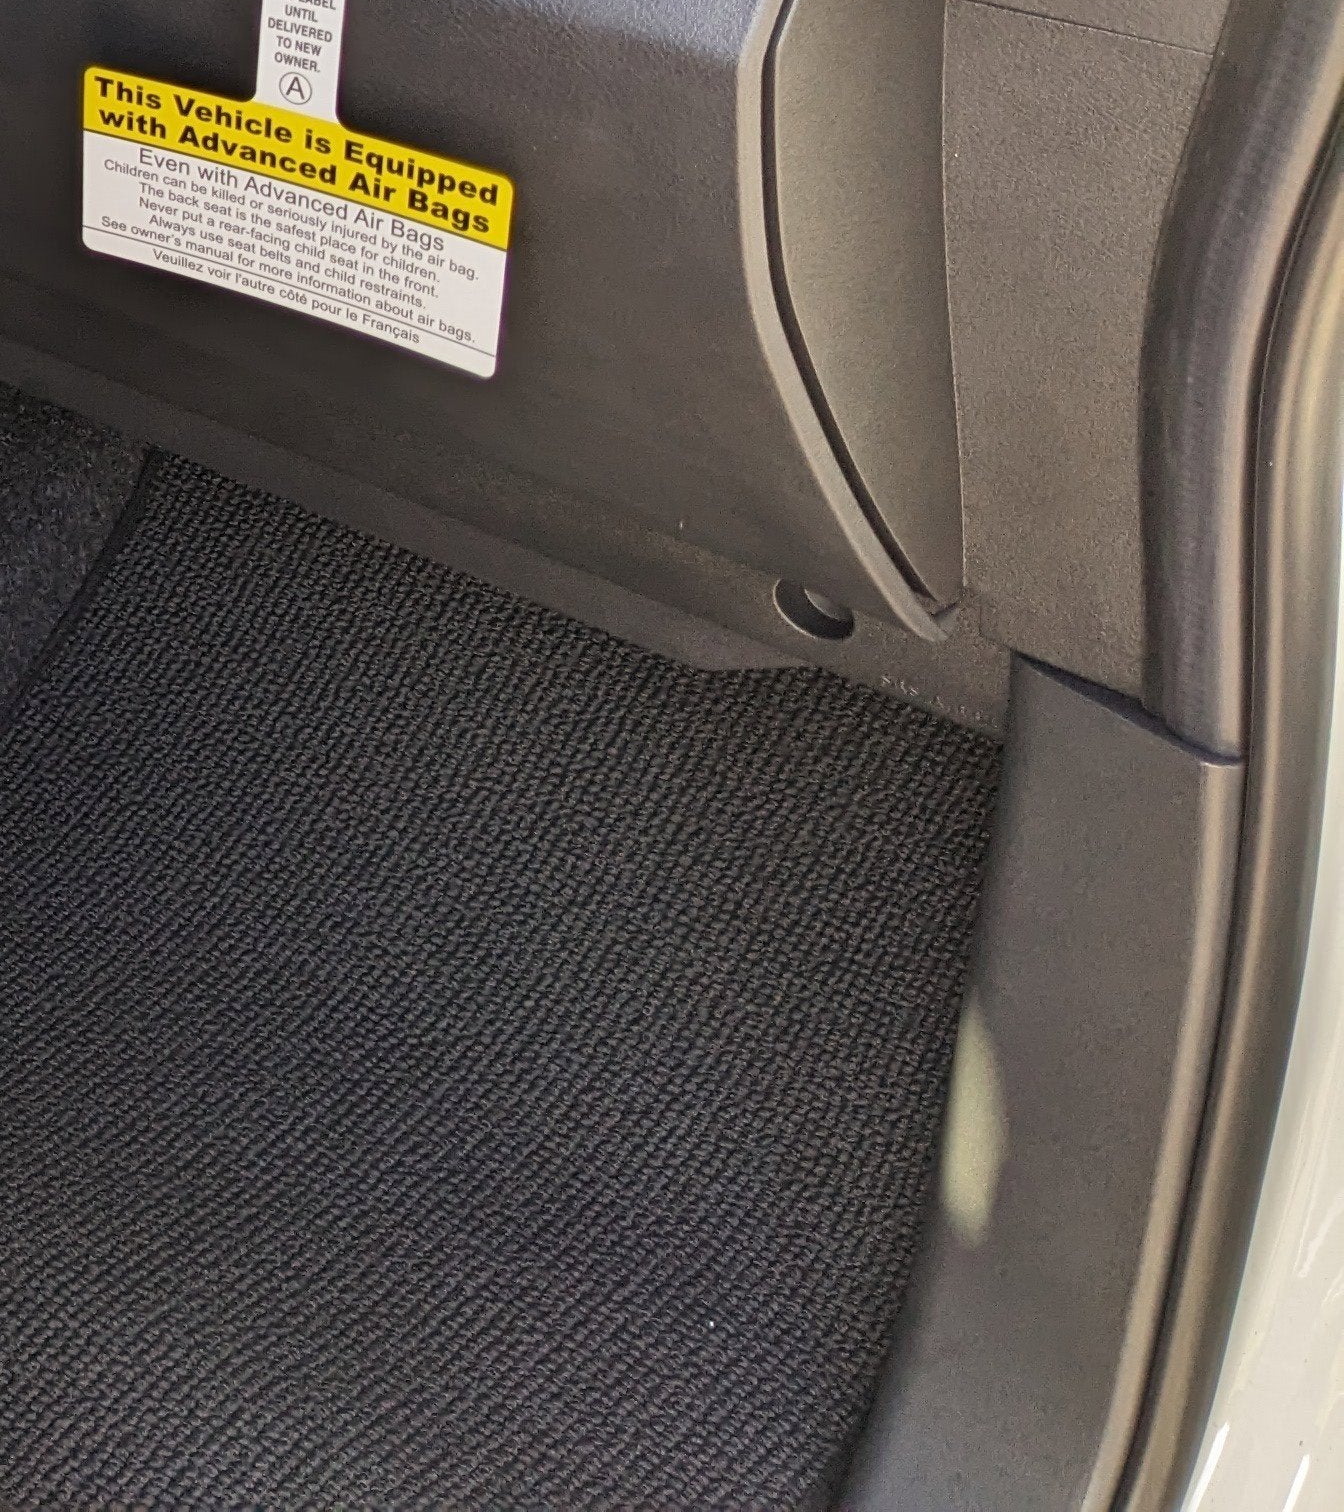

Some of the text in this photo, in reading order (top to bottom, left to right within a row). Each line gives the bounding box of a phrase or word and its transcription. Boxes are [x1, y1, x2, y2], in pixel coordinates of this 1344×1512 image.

[267, 17, 333, 43] DELIVERED
[274, 52, 321, 73] OWNER.
[276, 35, 322, 56] TO NEW
[285, 4, 319, 23] UNTIL
[285, 76, 305, 100] A
[94, 75, 499, 207] This Vehicle is Equipped
[98, 108, 490, 234] with Advanced Air Bags
[104, 158, 479, 282] Children can be killed or seriously injured by the air bag.
[138, 181, 441, 283] The back seat is the safest place for children.
[139, 147, 445, 252] Even with Advanced Air Bags
[139, 196, 439, 299] Never put a rear-facing child seat in the front.
[101, 215, 476, 344] See owner's manual for more information about air bags.
[149, 214, 427, 310] Always use seat belts and child restraints.
[152, 248, 204, 273] Veuillez
[207, 265, 232, 282] voir
[235, 272, 275, 295] l'autre
[311, 298, 343, 318] pour
[346, 307, 358, 322] le
[362, 313, 422, 345] Français
